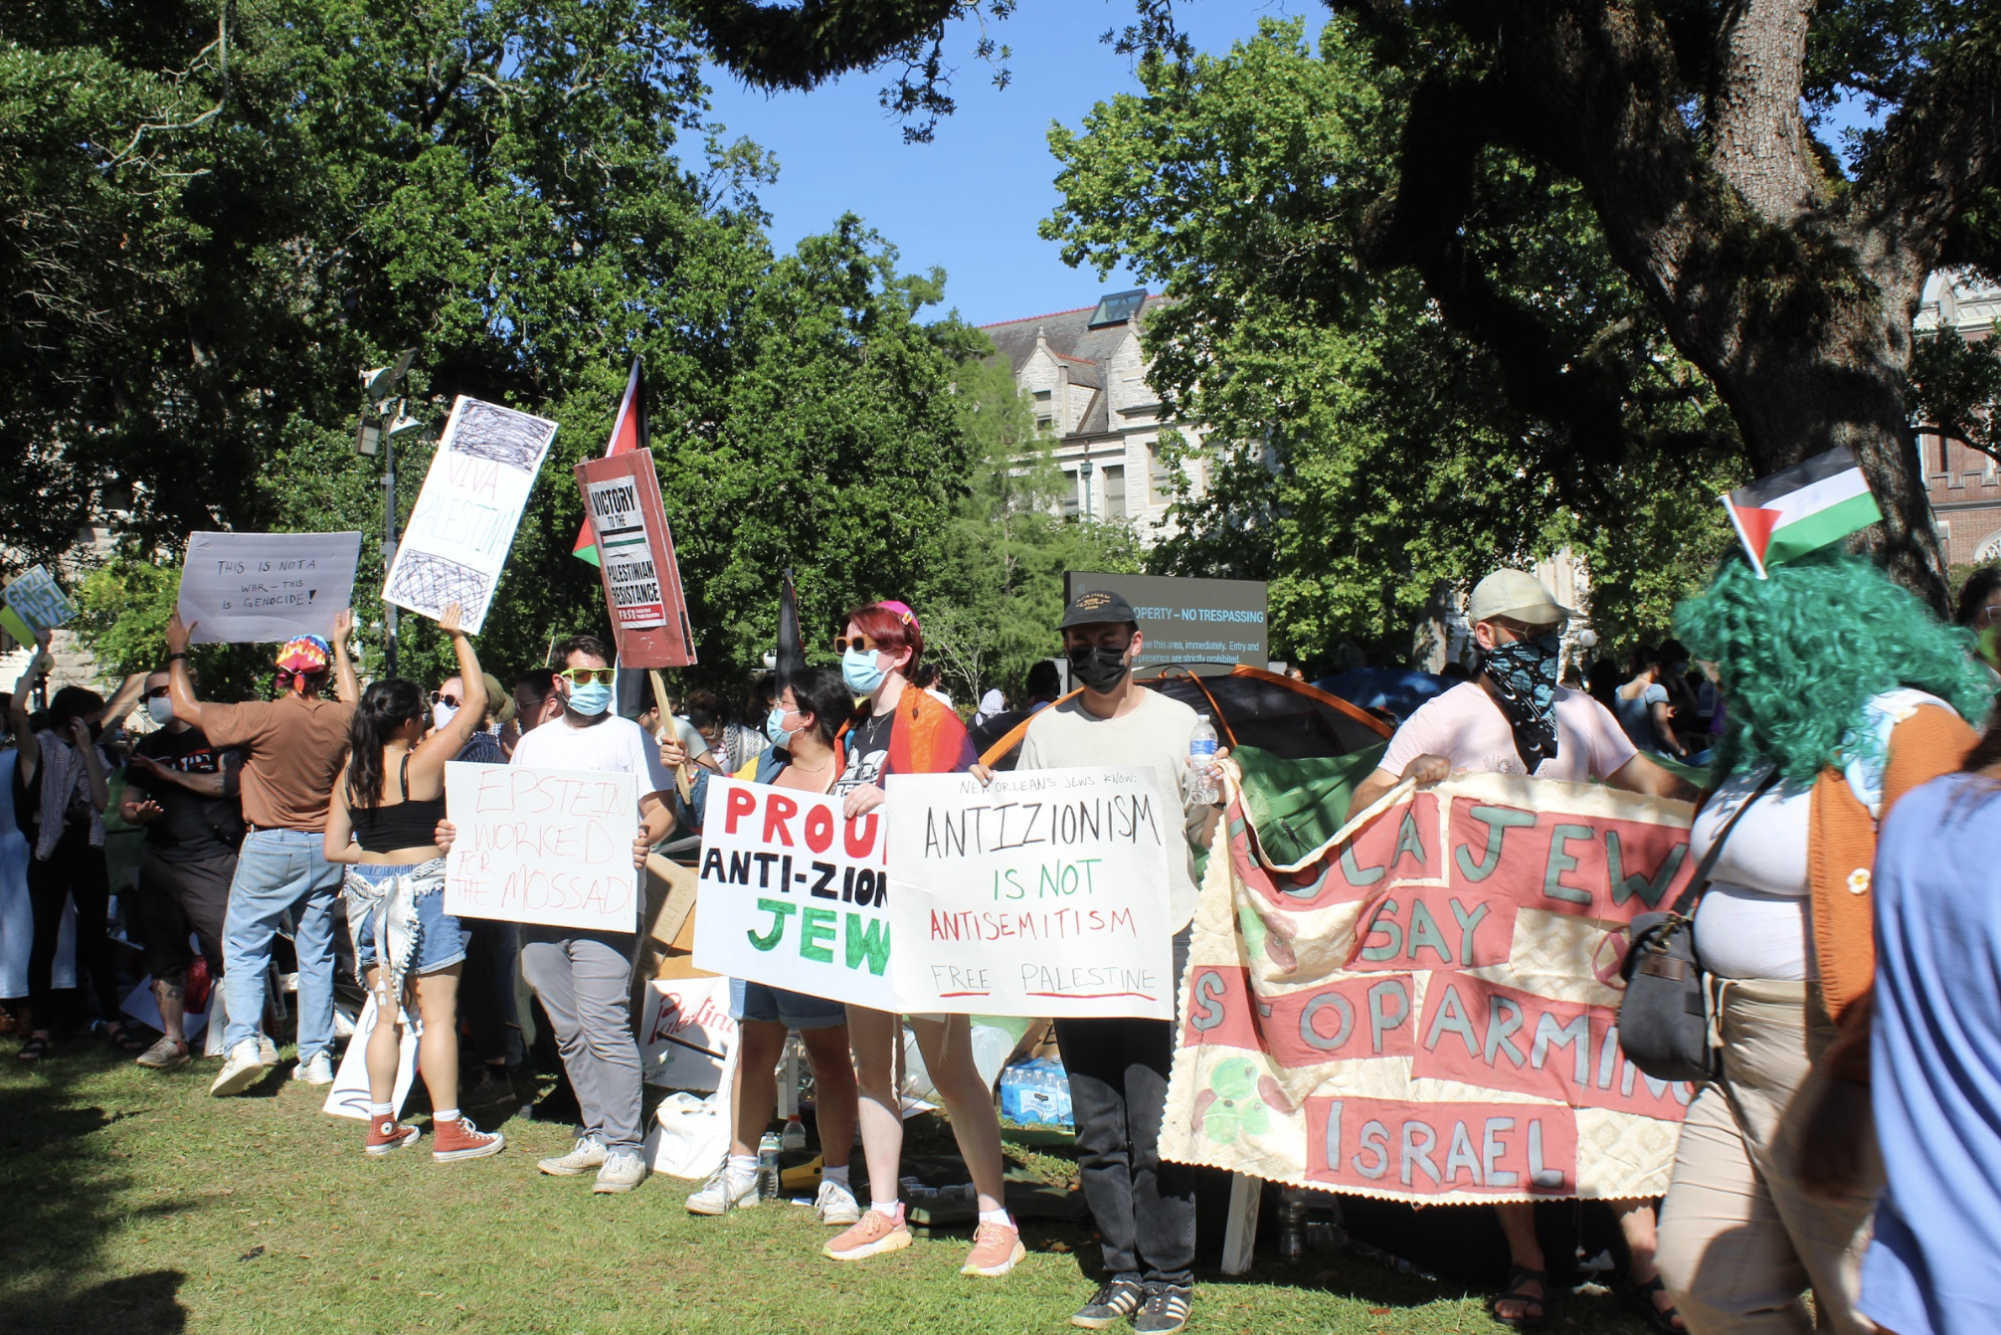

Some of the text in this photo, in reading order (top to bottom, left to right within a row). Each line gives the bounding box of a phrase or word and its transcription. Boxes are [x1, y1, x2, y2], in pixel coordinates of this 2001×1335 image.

[450, 453, 500, 502] VIVA
[591, 486, 636, 516] VICTORY
[608, 514, 626, 528] TO THE
[218, 560, 245, 576] THIS
[258, 561, 271, 573] IS
[606, 560, 655, 584] PALESTINIAN
[4, 568, 51, 606] GAZA
[14, 582, 61, 623] MUST
[222, 589, 318, 610] is GENOCIDE!
[240, 582, 269, 593] WAR
[282, 580, 304, 590] THIS
[611, 582, 660, 606] RESISTANCE
[1132, 606, 1172, 620] OPERTY
[1182, 609, 1196, 621] NO
[1198, 609, 1264, 624] TRESPASSING
[1154, 640, 1167, 649] this
[1168, 642, 1184, 650] area,
[1185, 640, 1226, 651] immediately.
[1229, 641, 1246, 652] Entry
[1247, 642, 1259, 651] and
[476, 768, 634, 818] EPSTEIN
[995, 777, 1056, 794] ORLEANS
[1064, 776, 1096, 789] JEWS
[1104, 774, 1138, 785] KNOW:
[473, 820, 614, 864] WORKED
[724, 787, 888, 866] PROU
[925, 794, 1162, 859] ANTIZIONISM
[457, 850, 497, 876] FOR
[700, 848, 888, 909] ANTI-ZION
[994, 858, 1102, 901] IS NOT
[451, 878, 492, 906] THE
[668, 878, 693, 914] FUND
[746, 898, 891, 976] JEW
[930, 907, 1138, 941] ANTISEMITISM
[1361, 898, 1491, 966] SAY
[931, 963, 1157, 992] FREE PALESTINE
[1190, 970, 1692, 1107] SOP ARMI
[1324, 1101, 1565, 1190] ISRAEL
